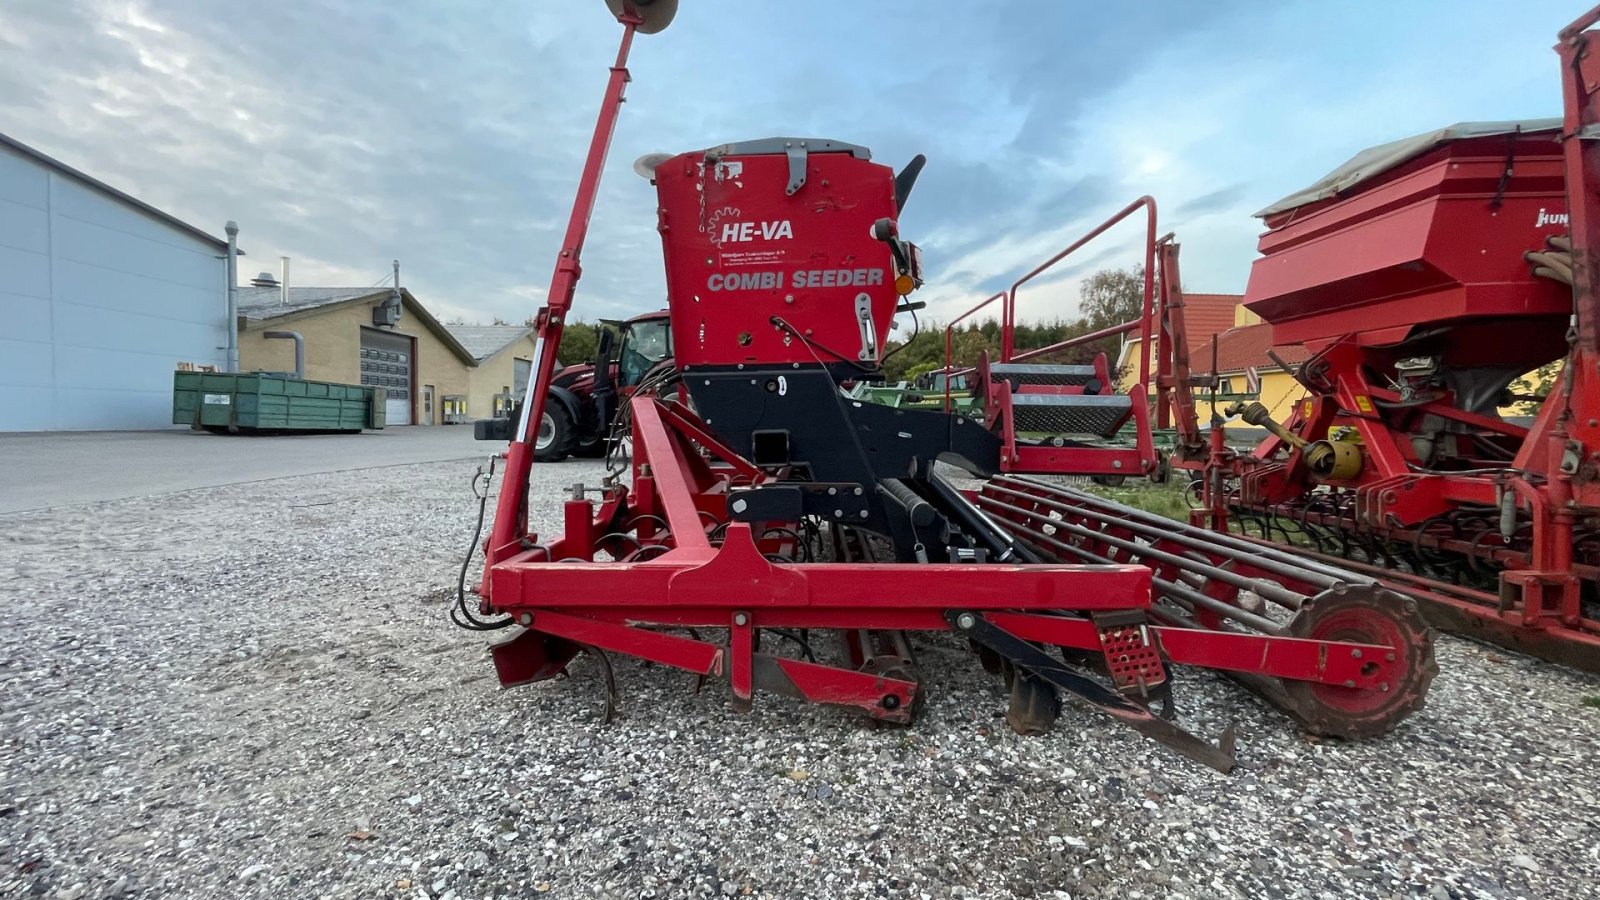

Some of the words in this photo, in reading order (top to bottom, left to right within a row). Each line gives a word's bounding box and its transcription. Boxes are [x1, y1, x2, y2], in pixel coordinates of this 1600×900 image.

[721, 220, 793, 242] HE-VA
[708, 272, 783, 291] COMBI
[792, 269, 883, 288] SEEDER
